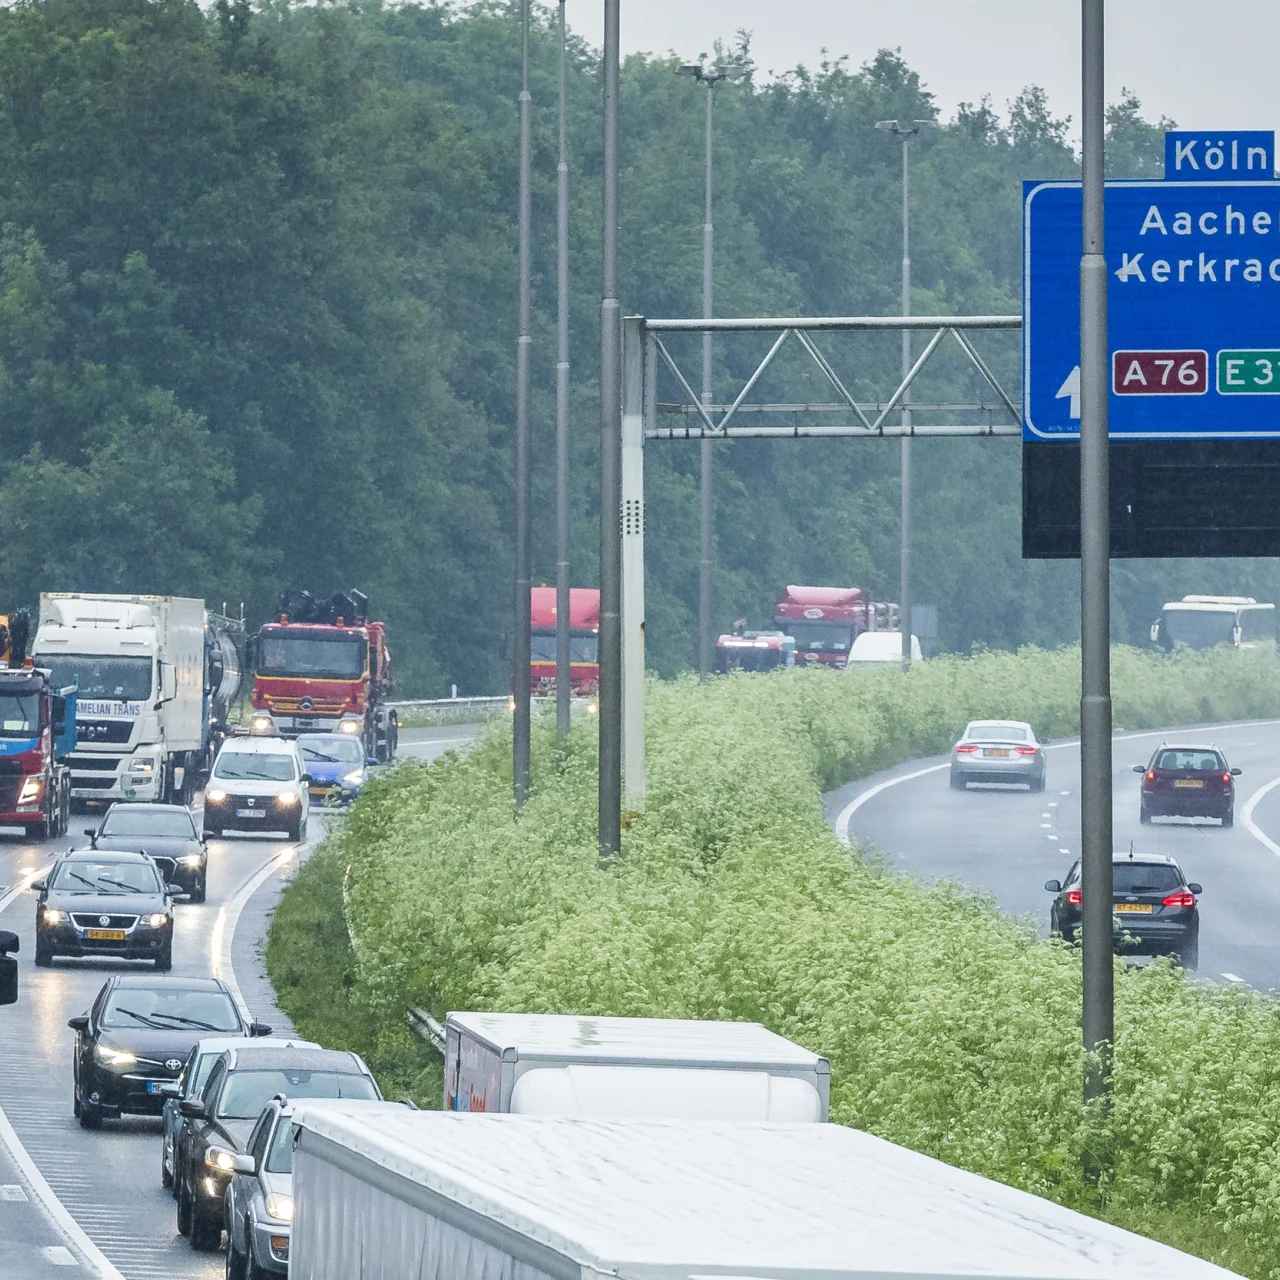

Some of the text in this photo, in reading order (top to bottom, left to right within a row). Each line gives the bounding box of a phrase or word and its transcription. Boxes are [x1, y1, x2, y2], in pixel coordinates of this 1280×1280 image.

[1174, 139, 1268, 171] Köln
[1126, 504, 1132, 514] 1
[113, 703, 141, 716] TRANS
